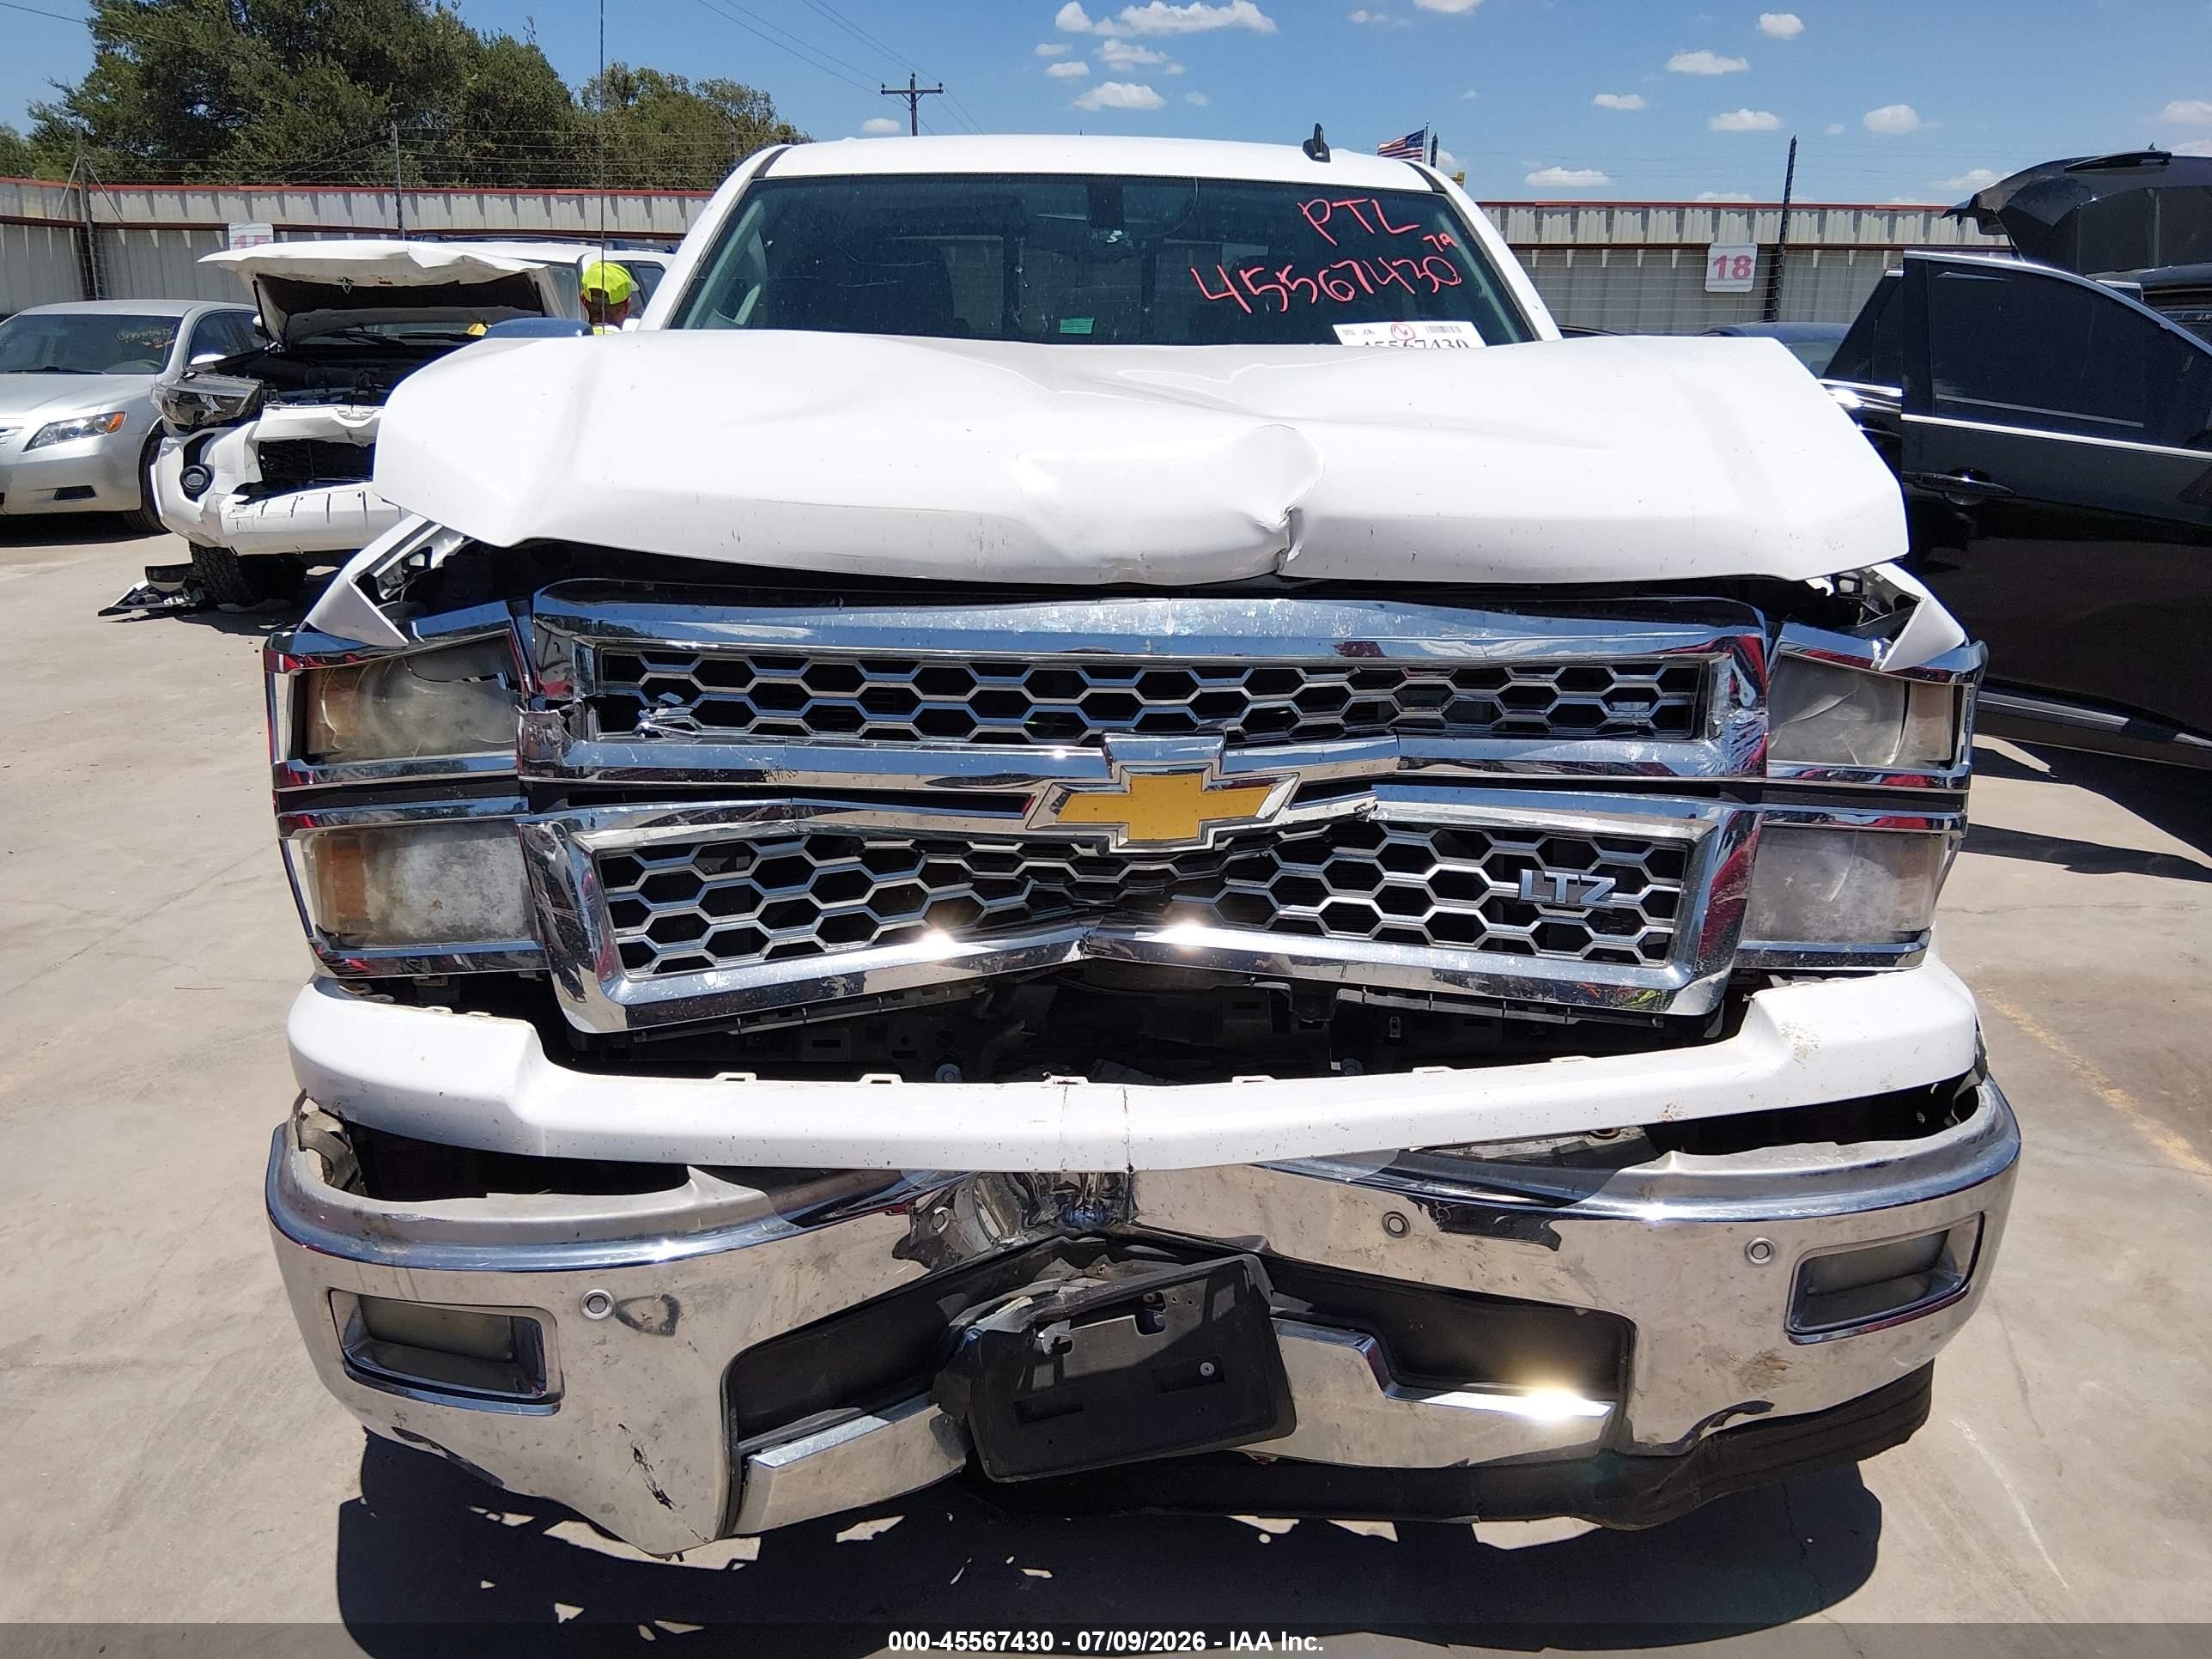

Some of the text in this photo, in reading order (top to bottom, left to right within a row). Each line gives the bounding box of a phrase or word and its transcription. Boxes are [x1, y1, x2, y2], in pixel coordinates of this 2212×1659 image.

[1297, 198, 1420, 246] PTL
[1190, 256, 1462, 314] 45567430
[1713, 255, 1752, 280] 18
[1520, 869, 1617, 908] LTZ
